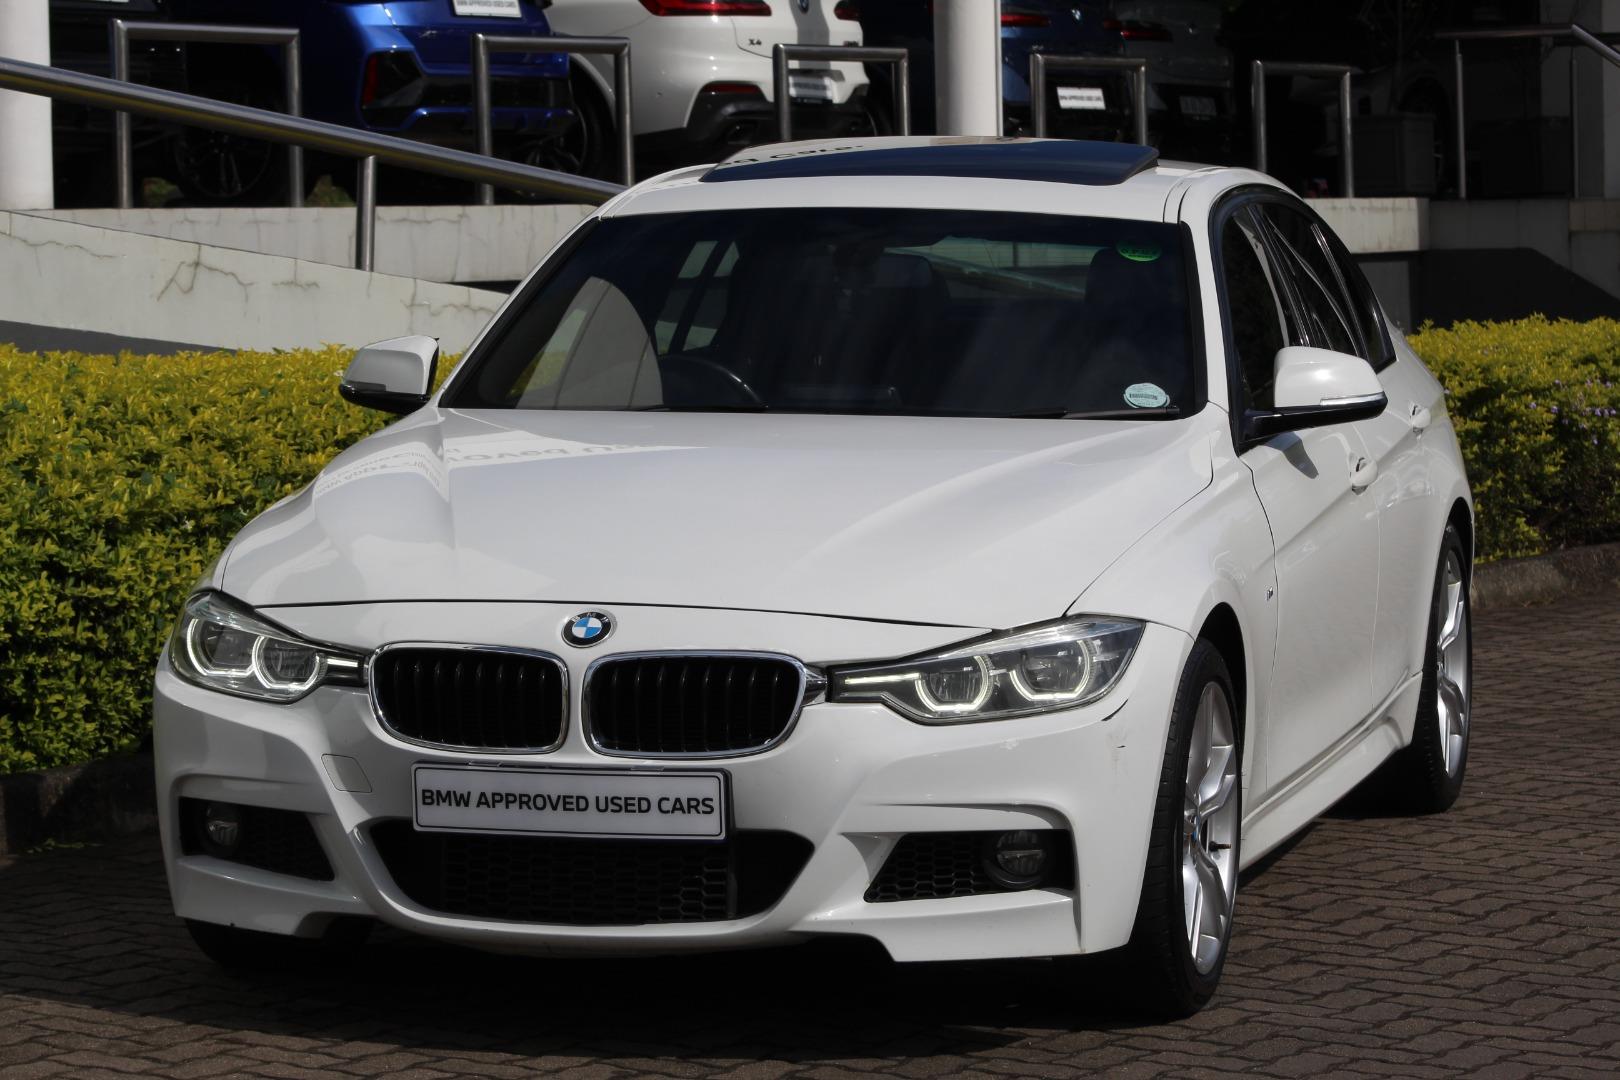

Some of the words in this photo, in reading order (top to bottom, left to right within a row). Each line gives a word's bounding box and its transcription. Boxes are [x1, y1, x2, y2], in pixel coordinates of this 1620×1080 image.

[421, 789, 471, 808] BMW
[476, 791, 589, 812] APPROVED
[595, 796, 651, 814] USED
[657, 797, 714, 815] CARS
